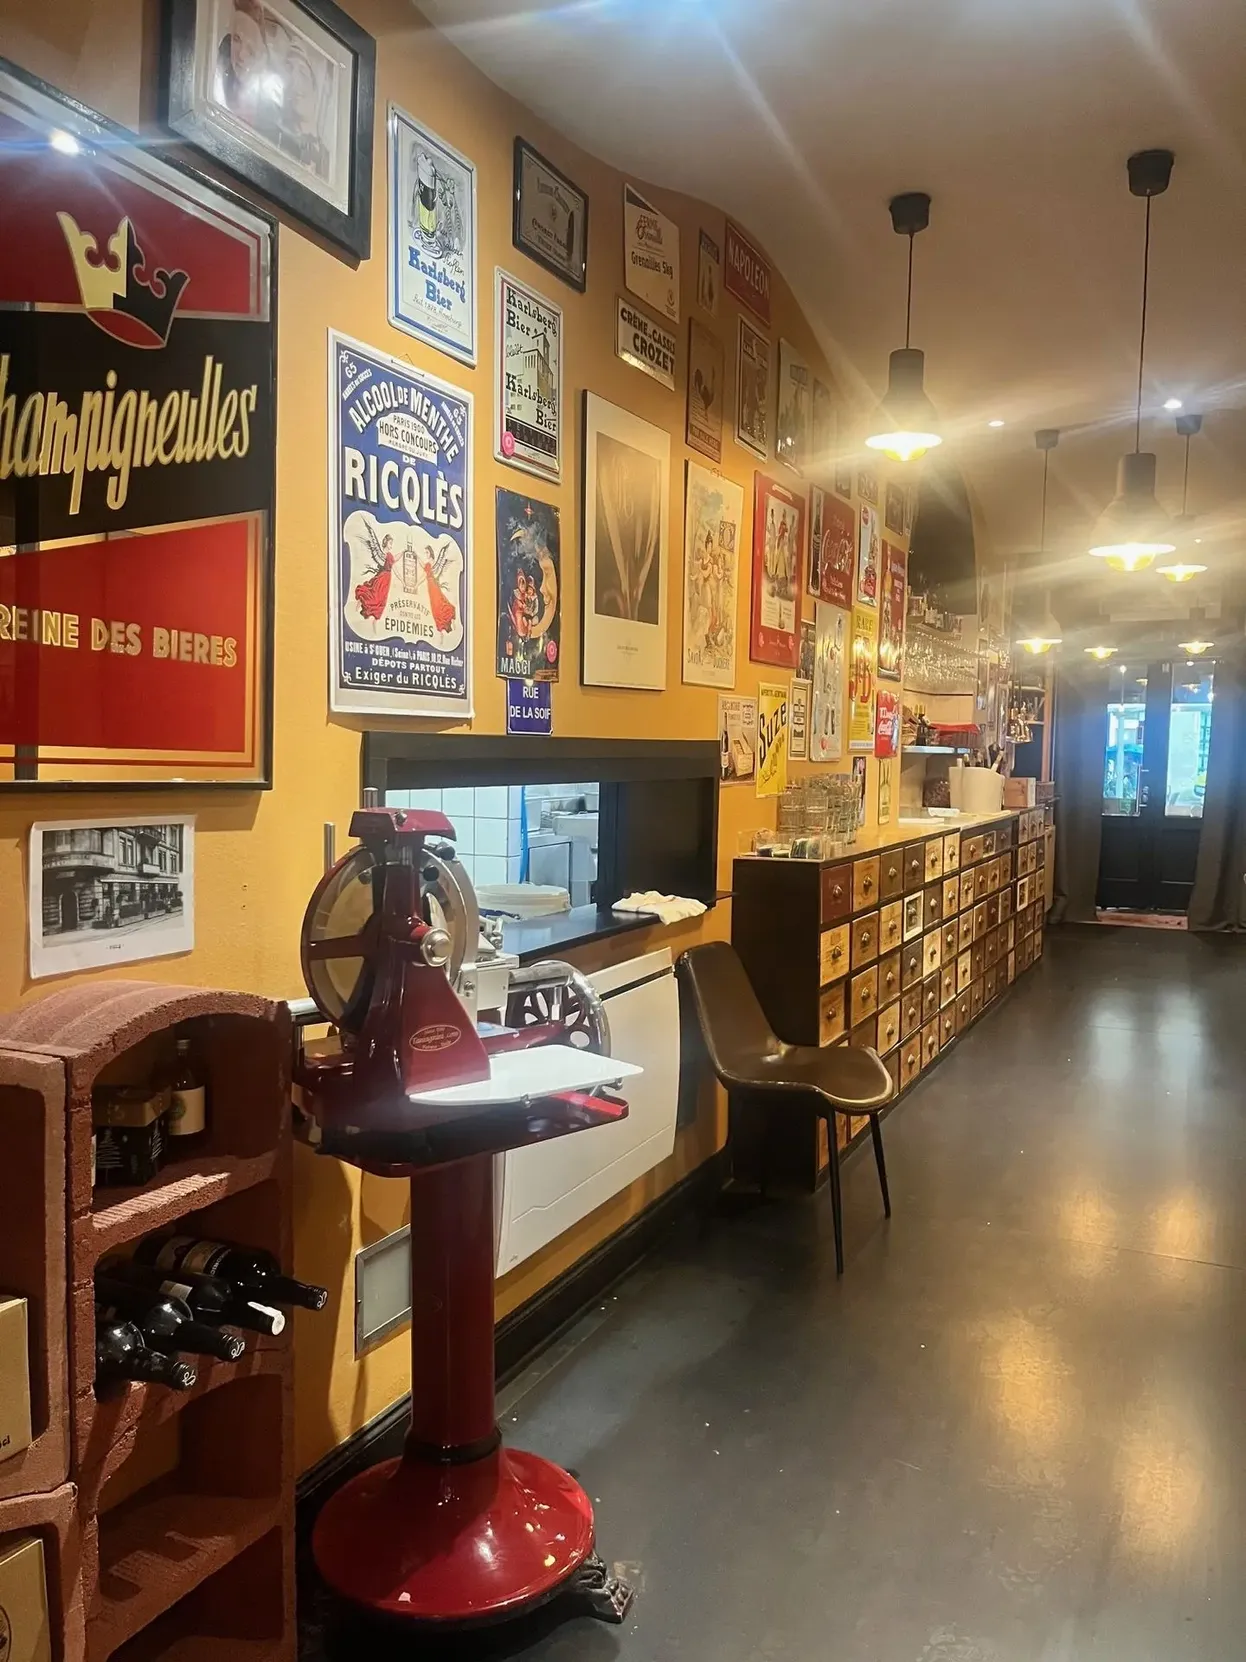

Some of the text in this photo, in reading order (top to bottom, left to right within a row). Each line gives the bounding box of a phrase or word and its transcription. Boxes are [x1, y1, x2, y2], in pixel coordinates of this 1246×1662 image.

[408, 245, 466, 304] Karlsberg
[425, 279, 453, 311] Bier
[506, 285, 558, 338] Karlsberg
[506, 307, 531, 336] Bier
[633, 332, 675, 375] CROZET
[506, 371, 557, 417] Karlsberg
[349, 381, 398, 433] ALCOOL
[397, 387, 409, 407] DE
[410, 388, 460, 463] MENTHE
[393, 414, 410, 428] PARIS
[535, 408, 557, 432] Bier
[379, 420, 437, 454] HORS CONCOURS
[402, 454, 416, 466] DE
[344, 446, 464, 529] RICQLÈS
[91, 616, 142, 656] DES
[153, 625, 238, 668] BIERES
[355, 666, 457, 690] Exiger du RICQLÈS
[409, 662, 446, 674] PARTOUT
[500, 657, 531, 675] MAGGI
[522, 686, 539, 699] RUE
[510, 705, 551, 720] DE LA SOIF
[759, 701, 787, 769] Suze
